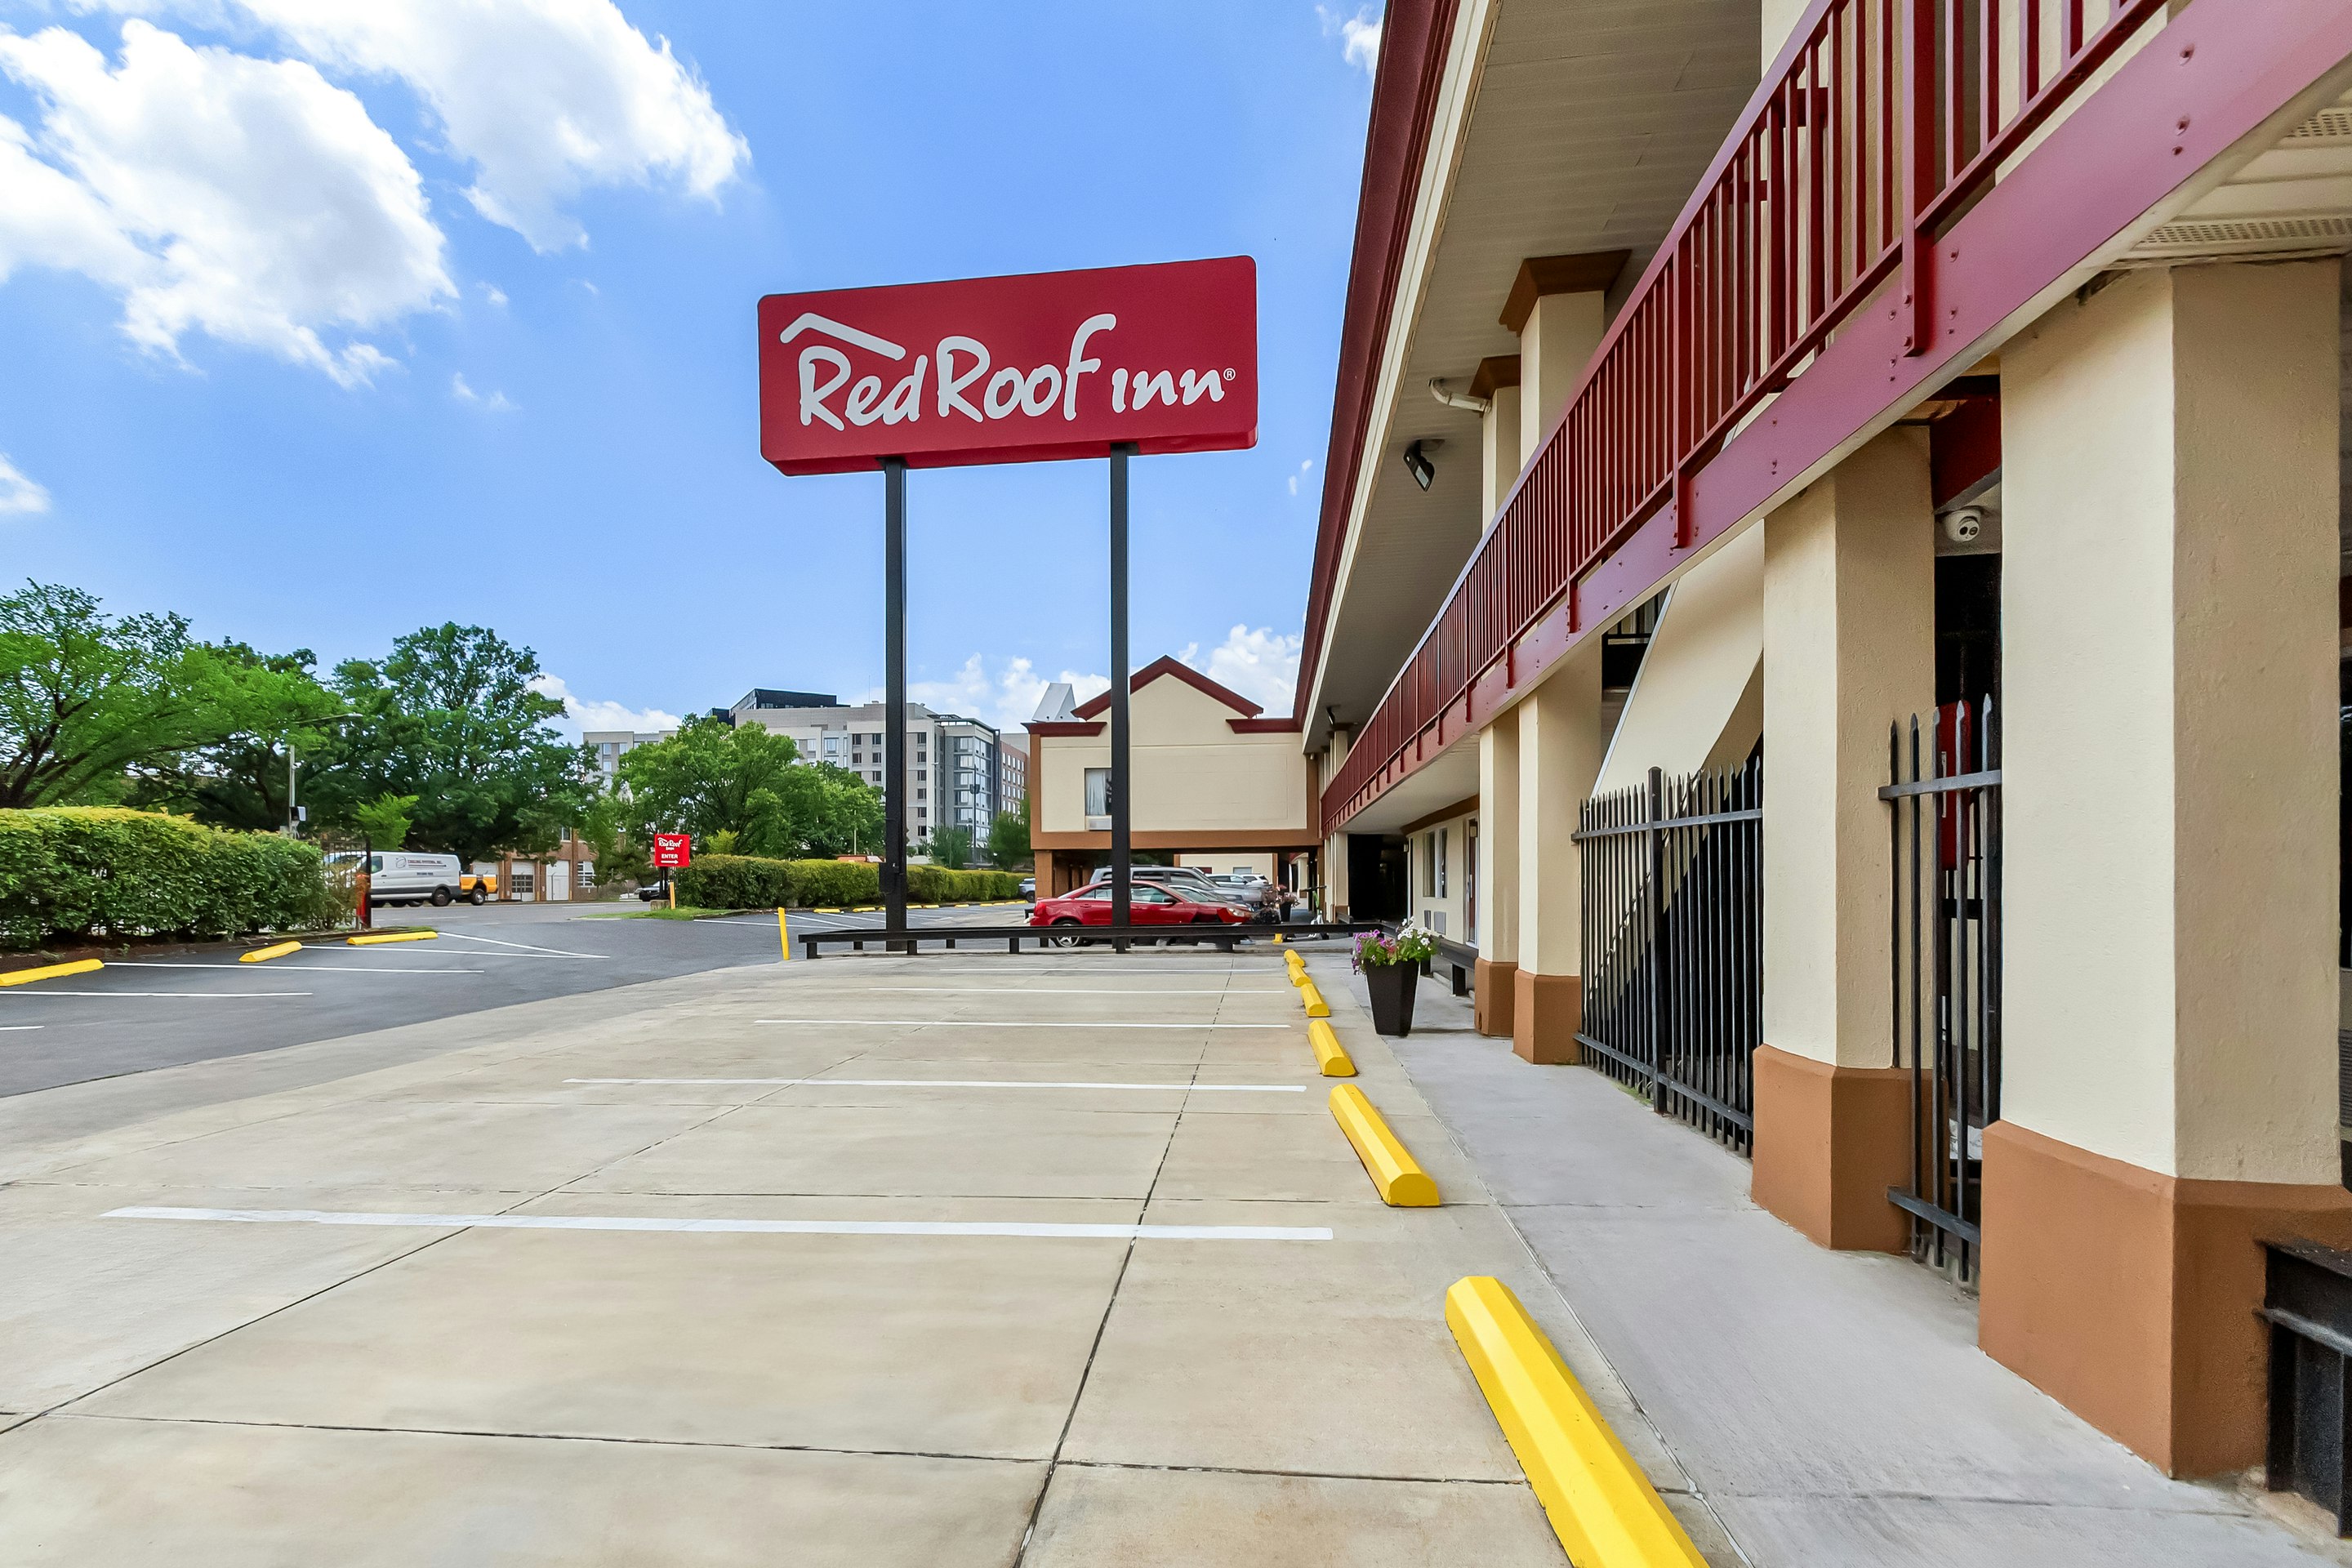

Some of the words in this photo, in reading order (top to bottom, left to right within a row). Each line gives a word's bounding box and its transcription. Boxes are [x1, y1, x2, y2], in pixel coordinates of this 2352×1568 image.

[798, 345, 928, 431] Red
[936, 313, 1117, 423] Roof
[669, 839, 683, 848] Roof
